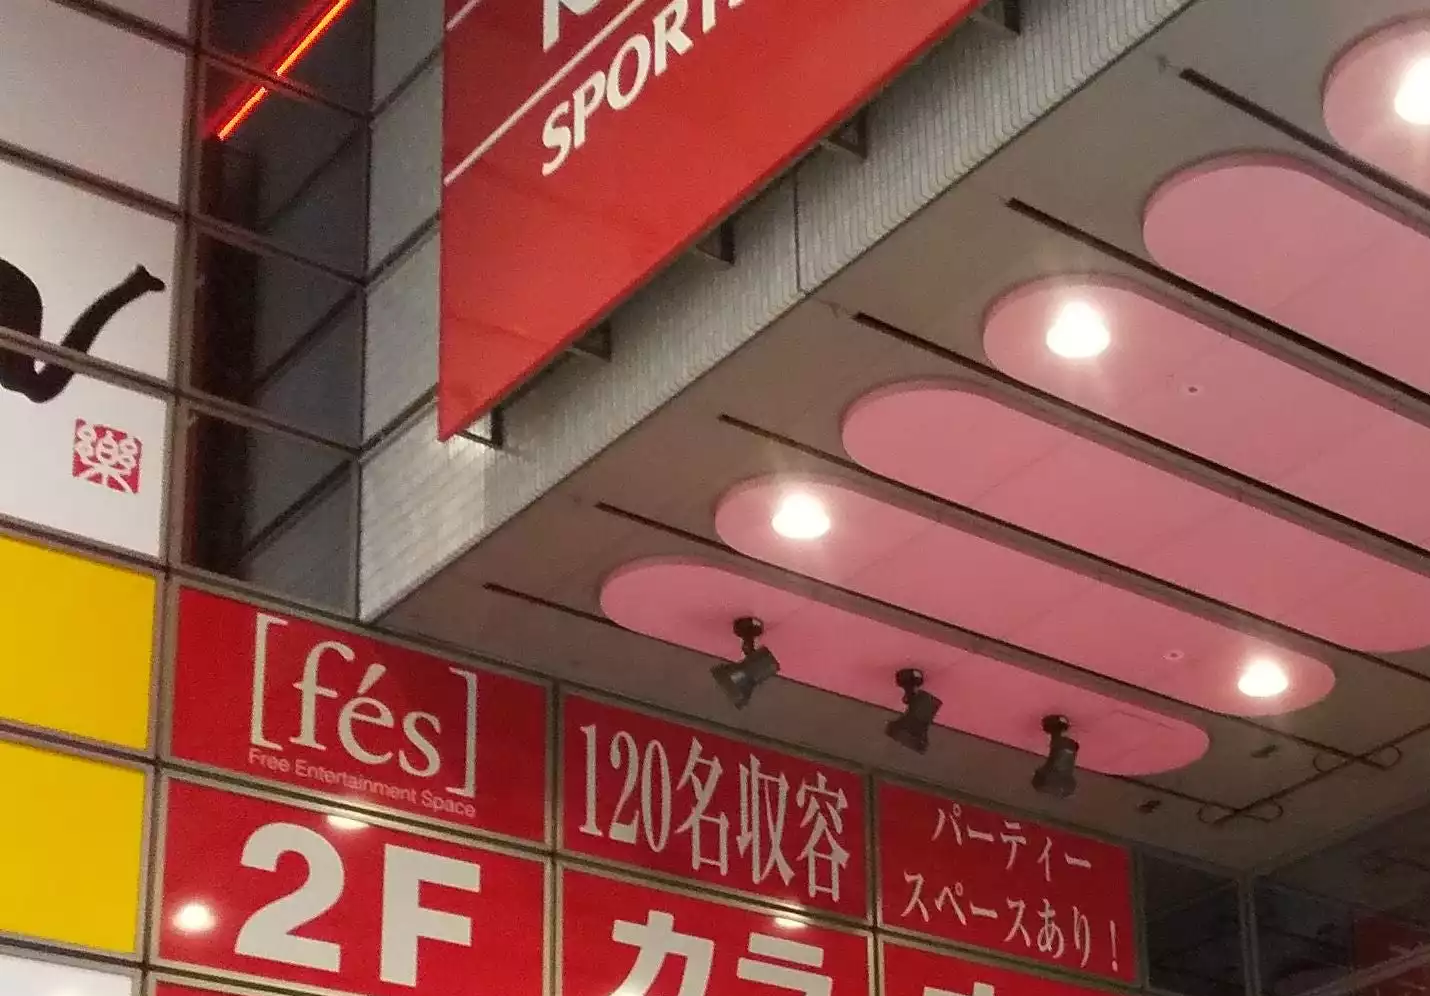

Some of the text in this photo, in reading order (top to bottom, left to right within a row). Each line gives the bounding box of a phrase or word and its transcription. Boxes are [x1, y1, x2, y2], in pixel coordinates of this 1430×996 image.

[541, 0, 745, 177] SPOR
[249, 748, 476, 818] Free Entertainment Space
[579, 722, 851, 902] 120名収容
[931, 803, 1093, 882] パーティー
[234, 821, 482, 987] 2F
